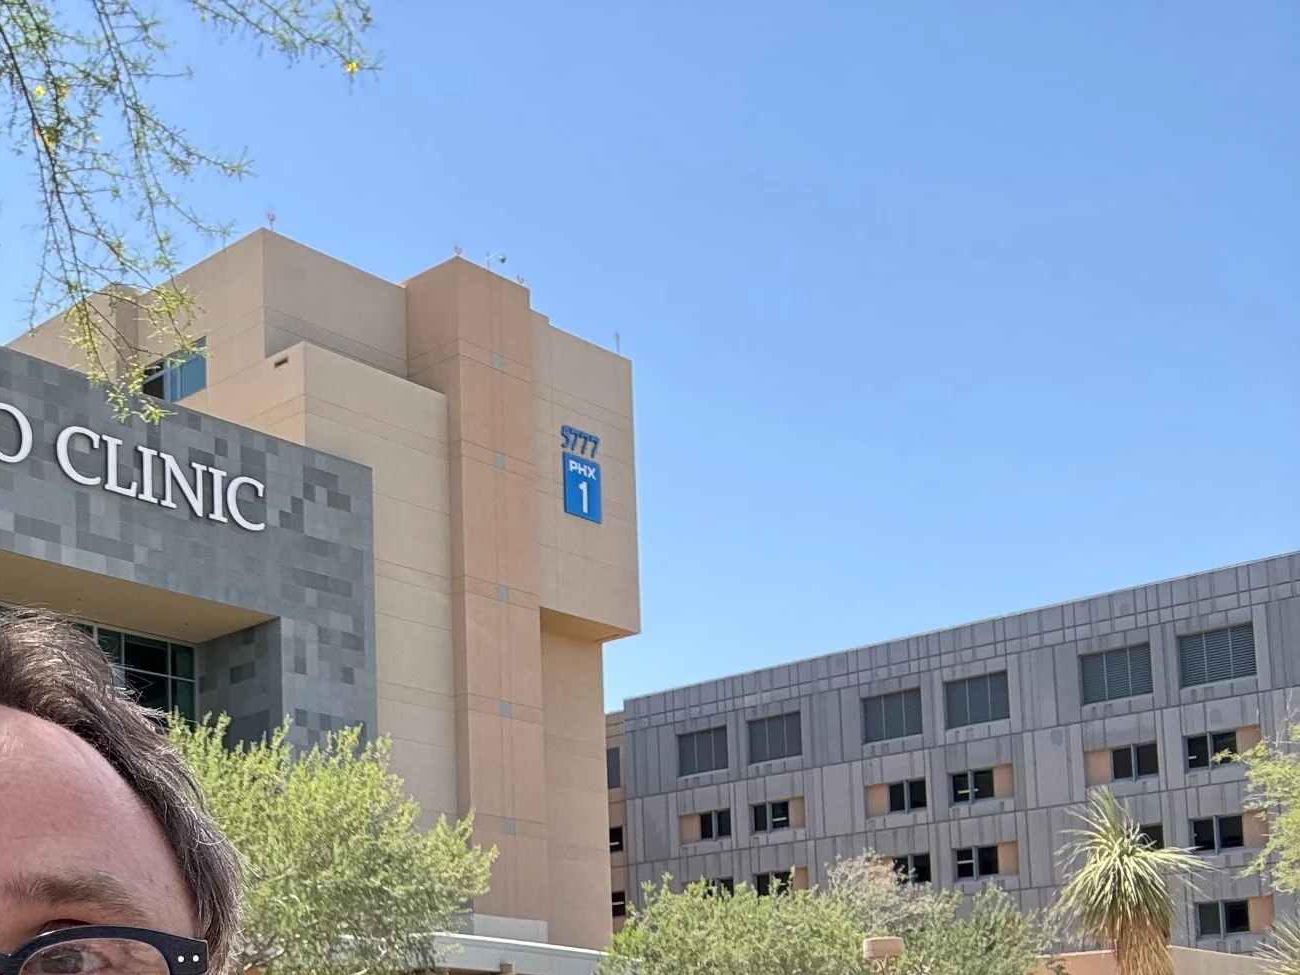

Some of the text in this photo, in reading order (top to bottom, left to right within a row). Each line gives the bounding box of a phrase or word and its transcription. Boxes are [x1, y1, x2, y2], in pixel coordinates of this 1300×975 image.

[561, 424, 600, 459] 5777
[55, 424, 267, 532] CLINIC
[568, 459, 597, 481] PHX
[578, 480, 589, 514] 1
